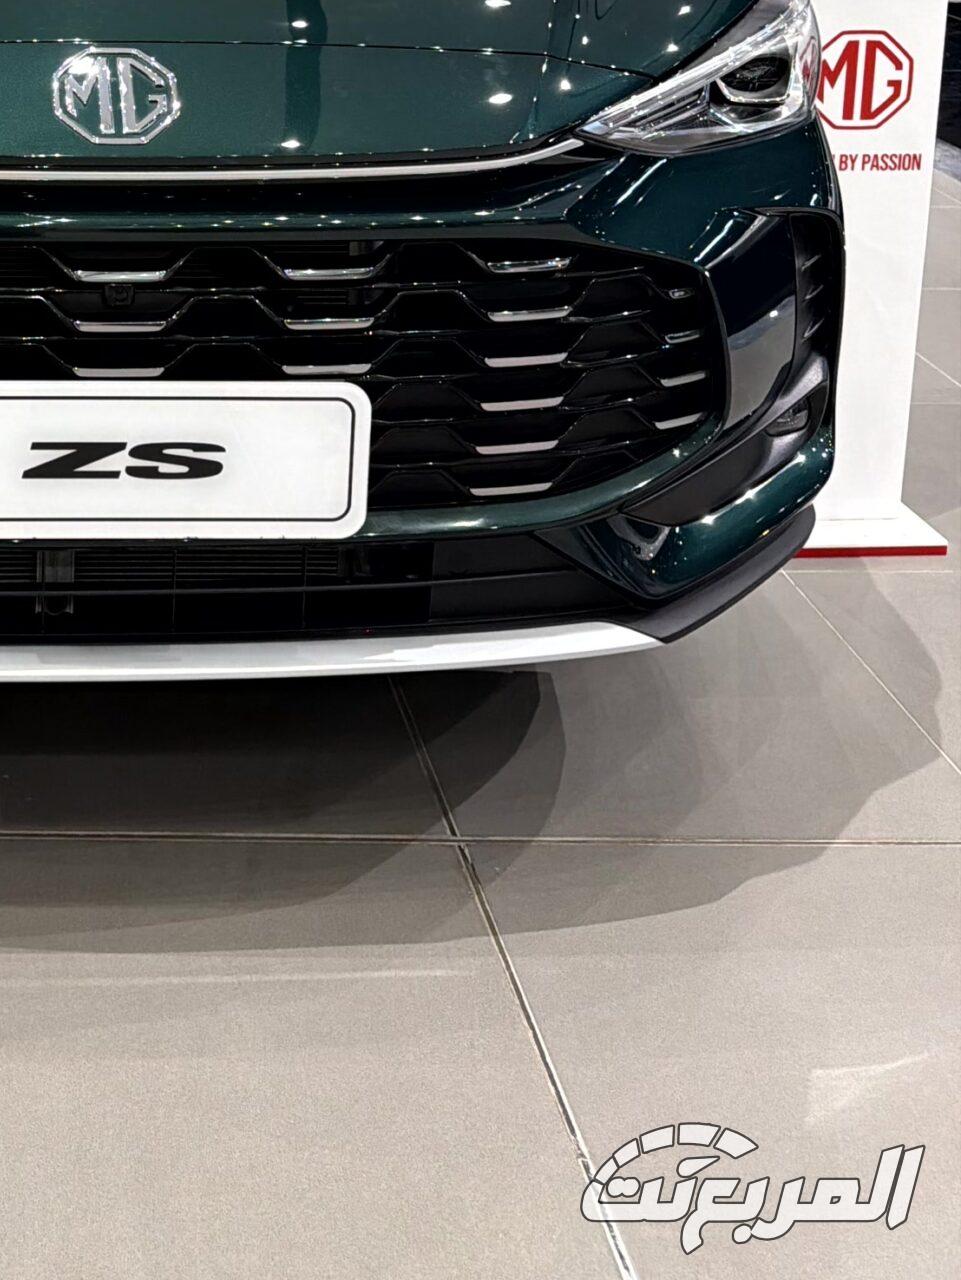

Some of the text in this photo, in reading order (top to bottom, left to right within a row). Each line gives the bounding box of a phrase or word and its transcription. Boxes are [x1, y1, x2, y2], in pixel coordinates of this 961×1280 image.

[62, 54, 170, 136] MG
[817, 39, 904, 121] MG
[838, 153, 859, 171] BY
[861, 153, 922, 171] PASSION
[21, 441, 227, 480] ZS
